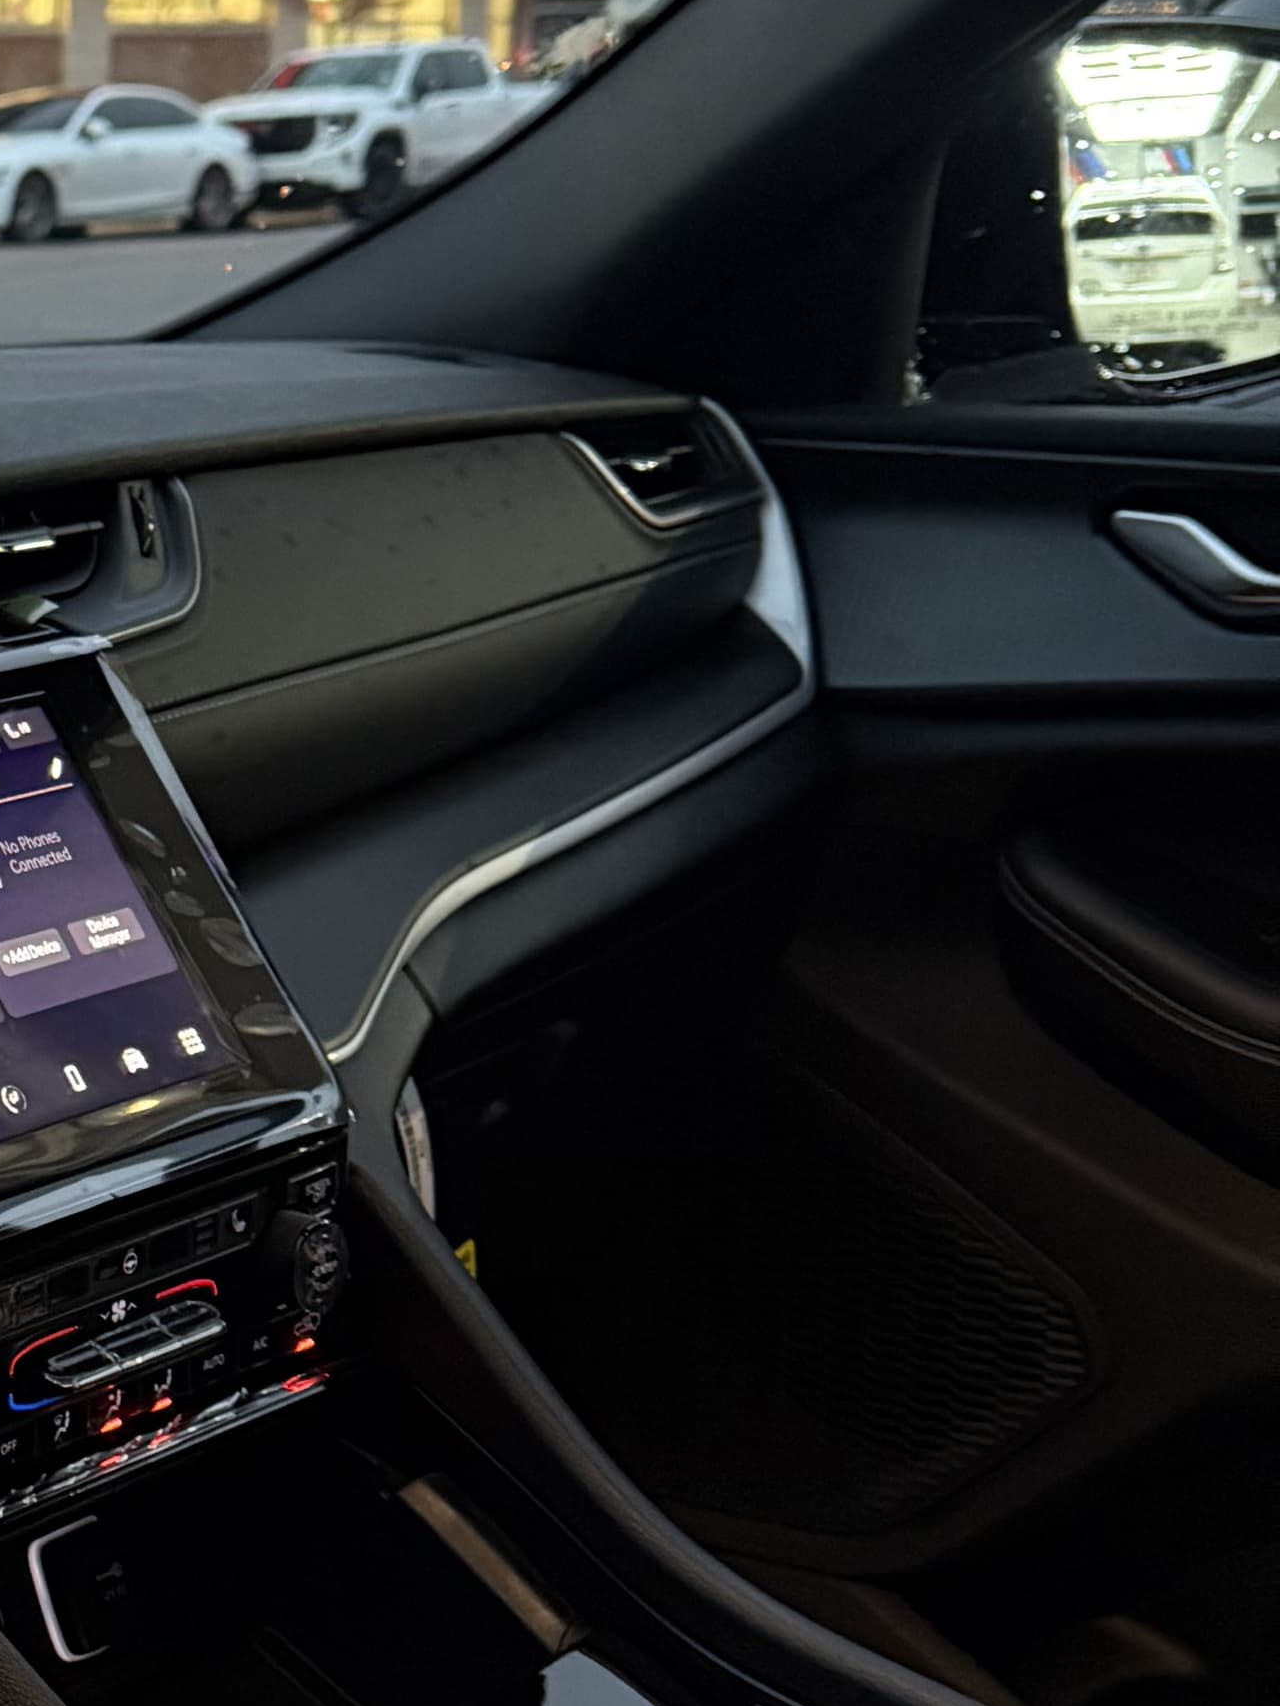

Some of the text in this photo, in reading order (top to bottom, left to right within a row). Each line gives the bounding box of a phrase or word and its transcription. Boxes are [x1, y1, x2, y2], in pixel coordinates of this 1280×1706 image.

[0, 831, 61, 855] No Phones
[9, 848, 72, 874] Connected
[0, 1439, 18, 1456] OFF
